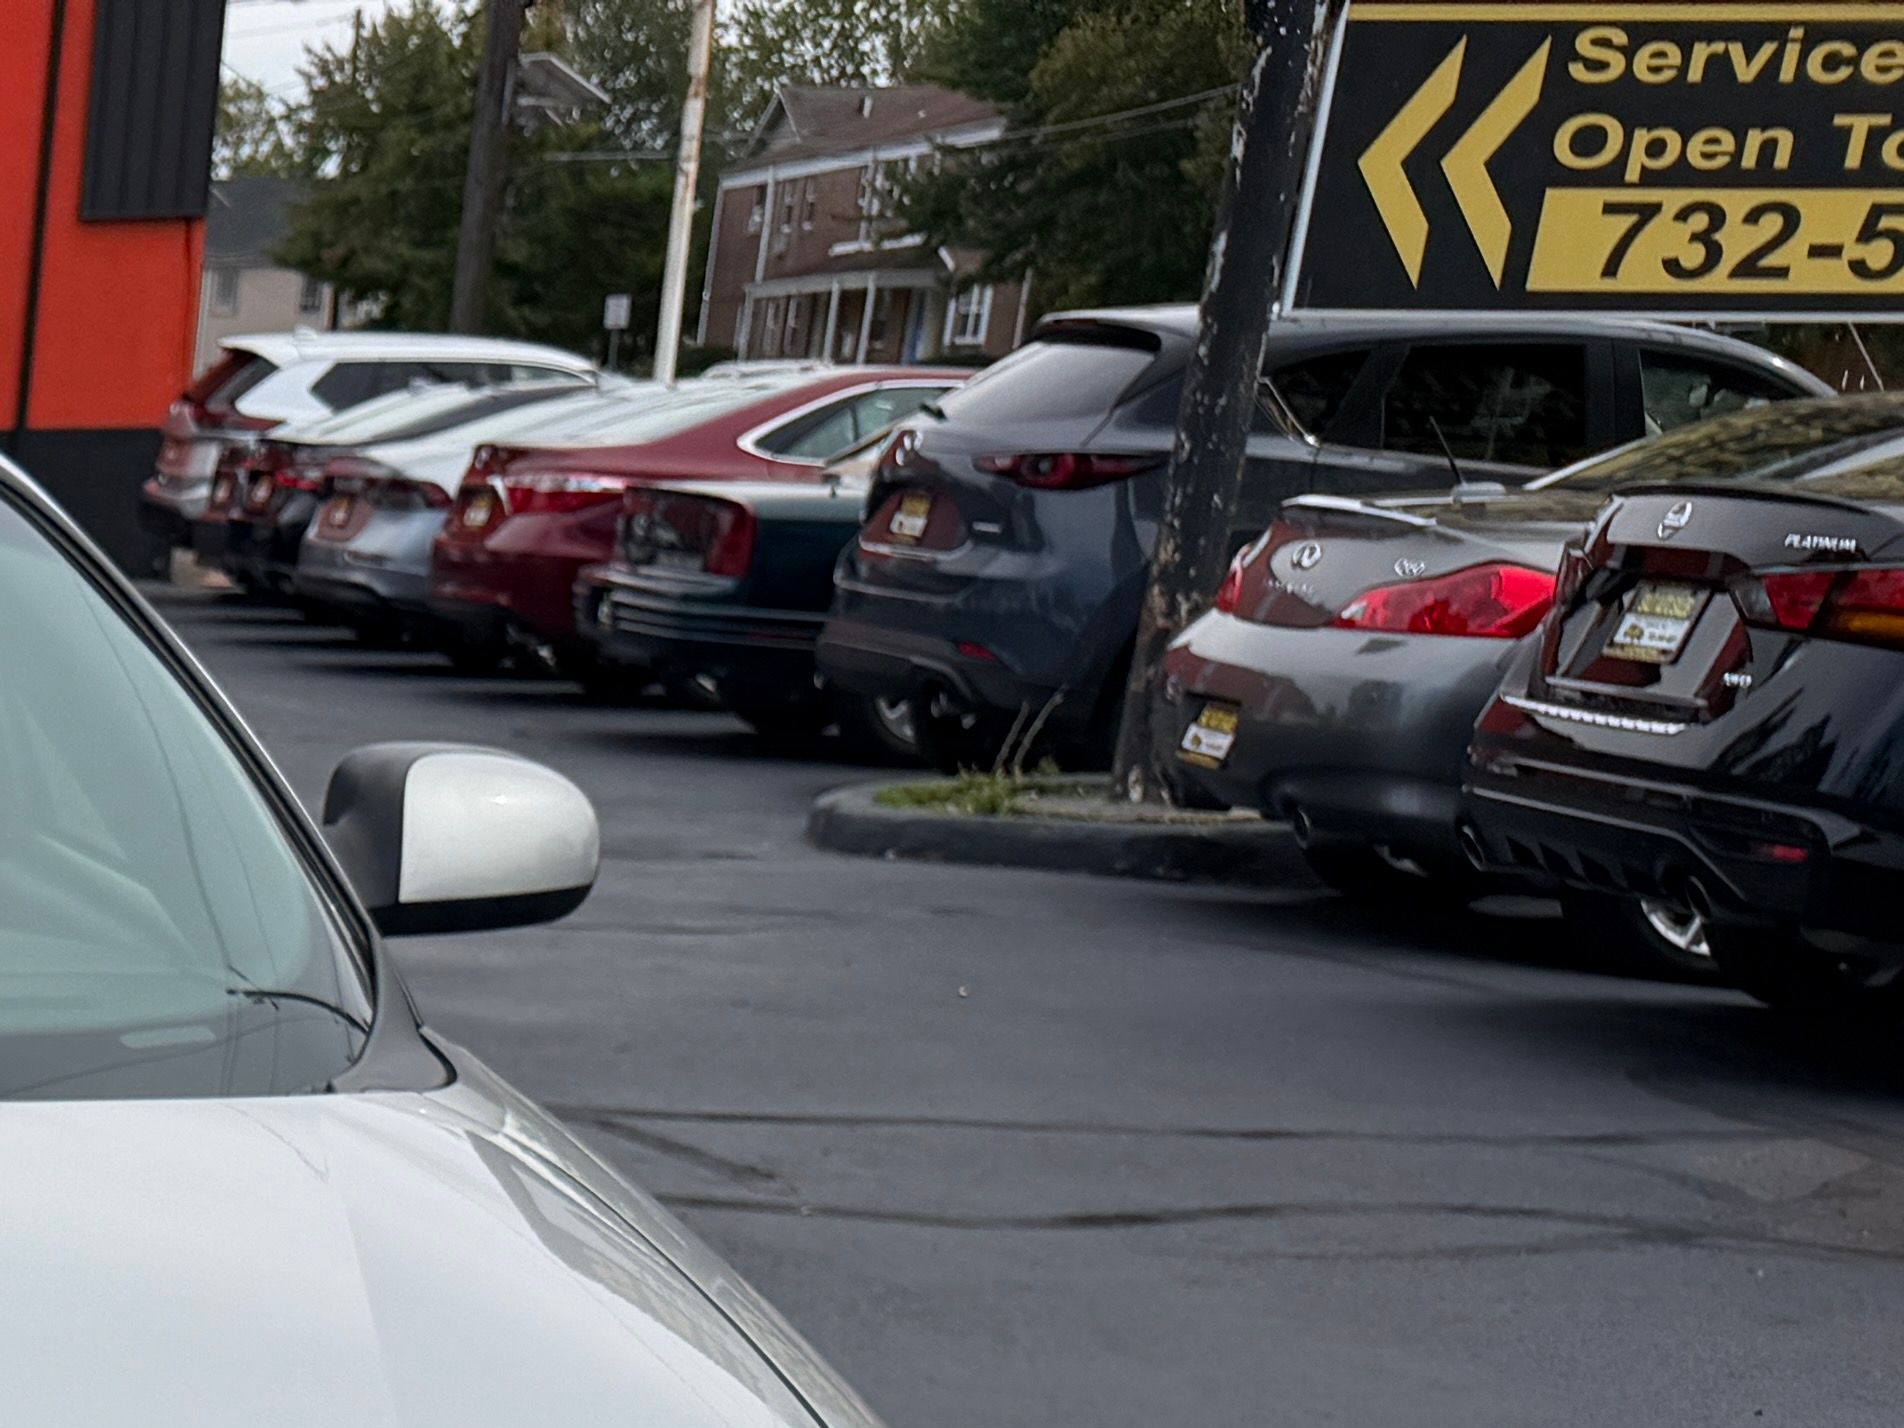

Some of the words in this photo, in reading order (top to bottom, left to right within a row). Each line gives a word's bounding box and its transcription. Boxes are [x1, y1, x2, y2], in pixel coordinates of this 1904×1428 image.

[1567, 24, 1904, 85] Service
[1552, 112, 1795, 184] Open
[1599, 200, 1904, 281] 732-5
